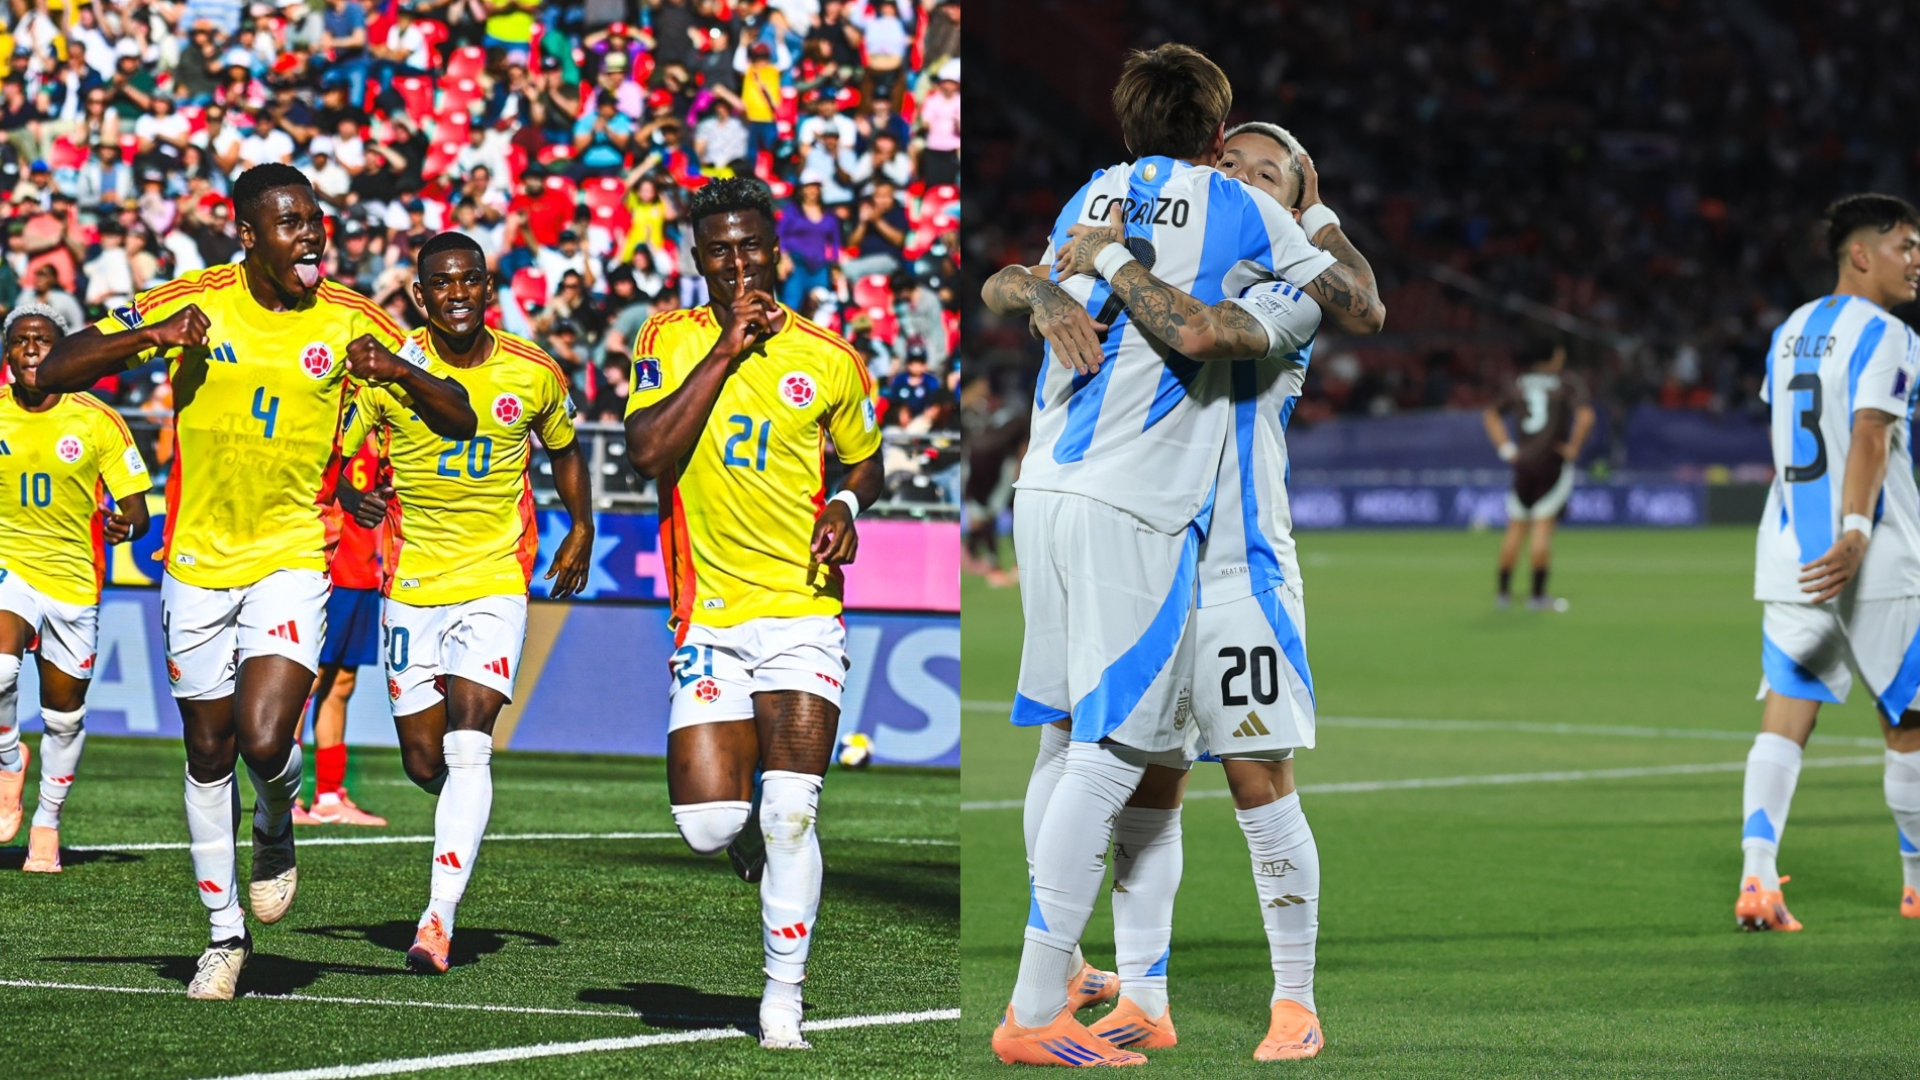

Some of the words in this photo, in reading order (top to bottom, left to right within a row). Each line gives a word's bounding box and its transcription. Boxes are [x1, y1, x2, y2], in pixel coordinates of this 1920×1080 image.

[1782, 334, 1836, 358] SOLER
[223, 412, 295, 437] TOO
[251, 386, 280, 439] 4
[1785, 373, 1828, 483] 3
[437, 436, 493, 479] 20
[724, 414, 771, 471] 21
[20, 472, 51, 507] 10
[352, 458, 367, 491] 6
[676, 645, 713, 689] 21
[1218, 646, 1279, 706] 20
[1259, 858, 1299, 877] AFA
